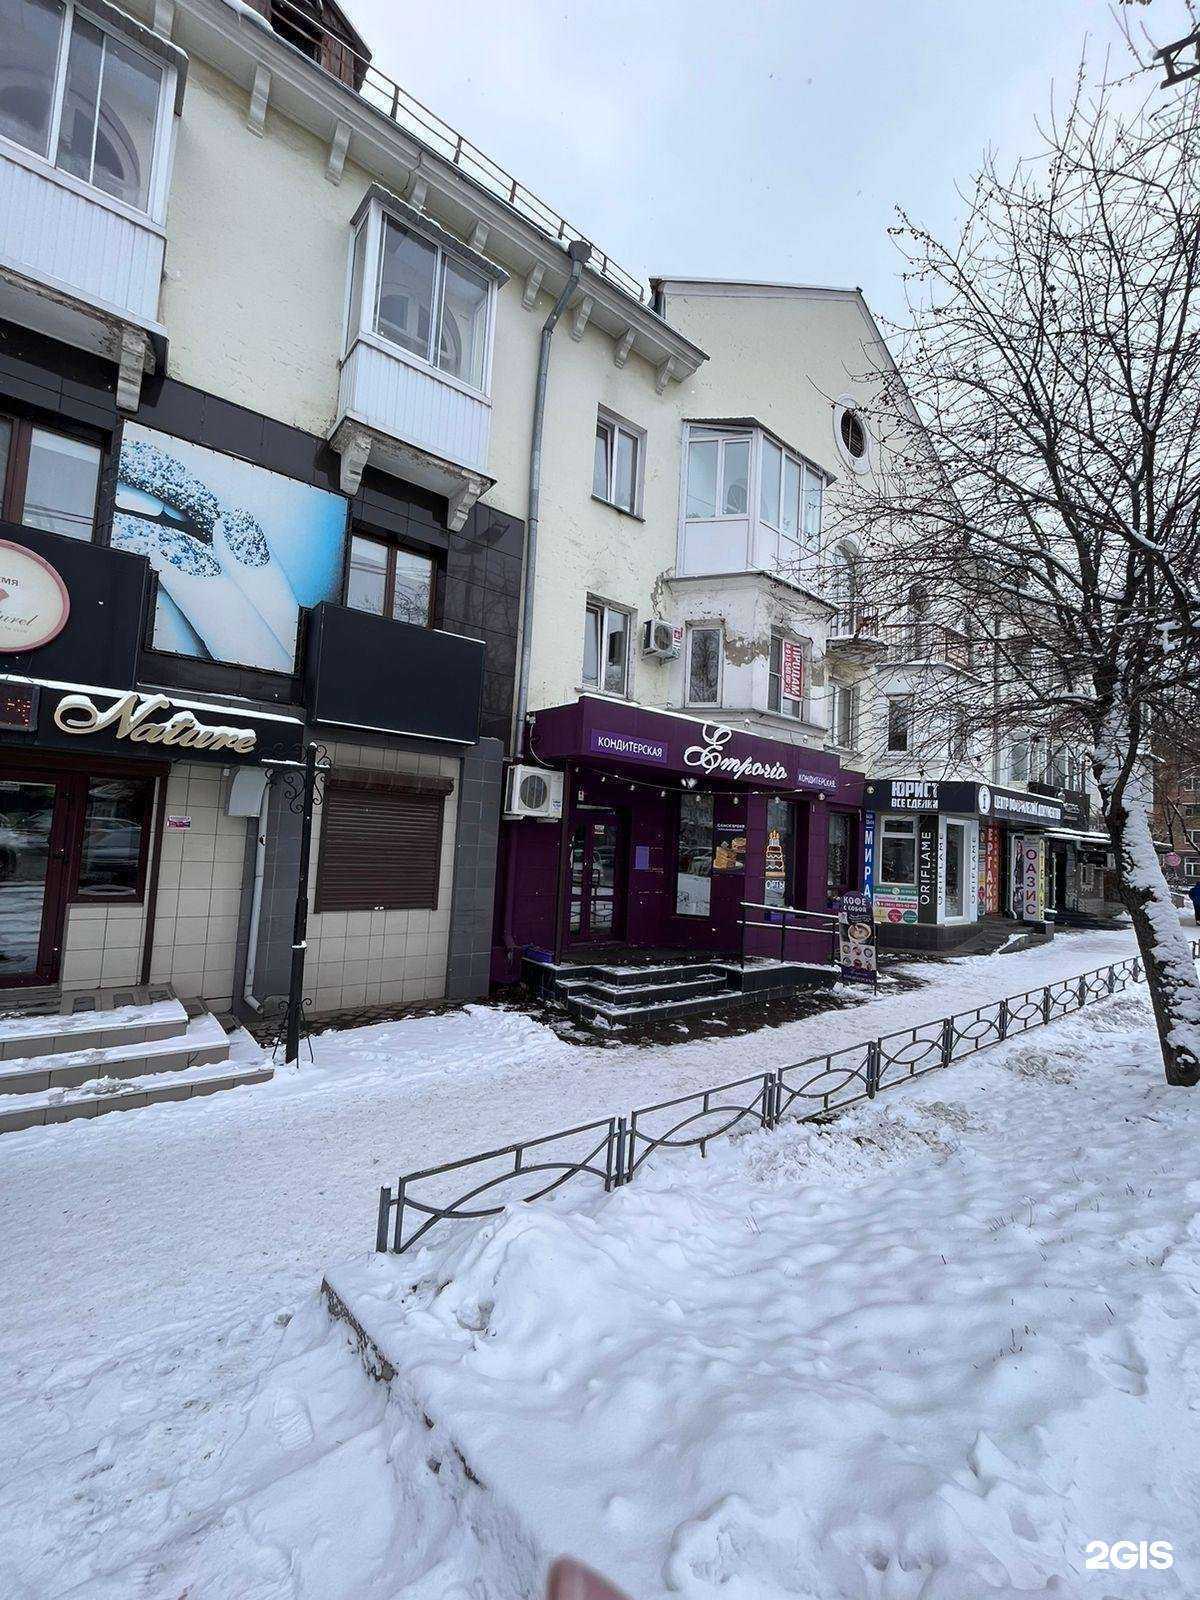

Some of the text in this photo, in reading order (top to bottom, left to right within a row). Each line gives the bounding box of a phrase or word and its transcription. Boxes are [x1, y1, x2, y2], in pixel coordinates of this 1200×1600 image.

[792, 643, 801, 697] ПРОДАМ
[54, 692, 257, 754] Nature
[597, 736, 663, 758] КОНДИТЕРСКАЯ
[683, 722, 788, 780] Emporio
[798, 773, 837, 788] КОНДИТЕРСКАЯ
[891, 781, 940, 798] ЮРИСТ
[891, 798, 939, 809] ВСЕ СДЕЛКИ
[920, 831, 932, 905] ORIFLAME
[765, 880, 785, 891] ОРТЫ
[1026, 849, 1038, 915] ОАЗИС
[843, 896, 866, 906] КОФЕ
